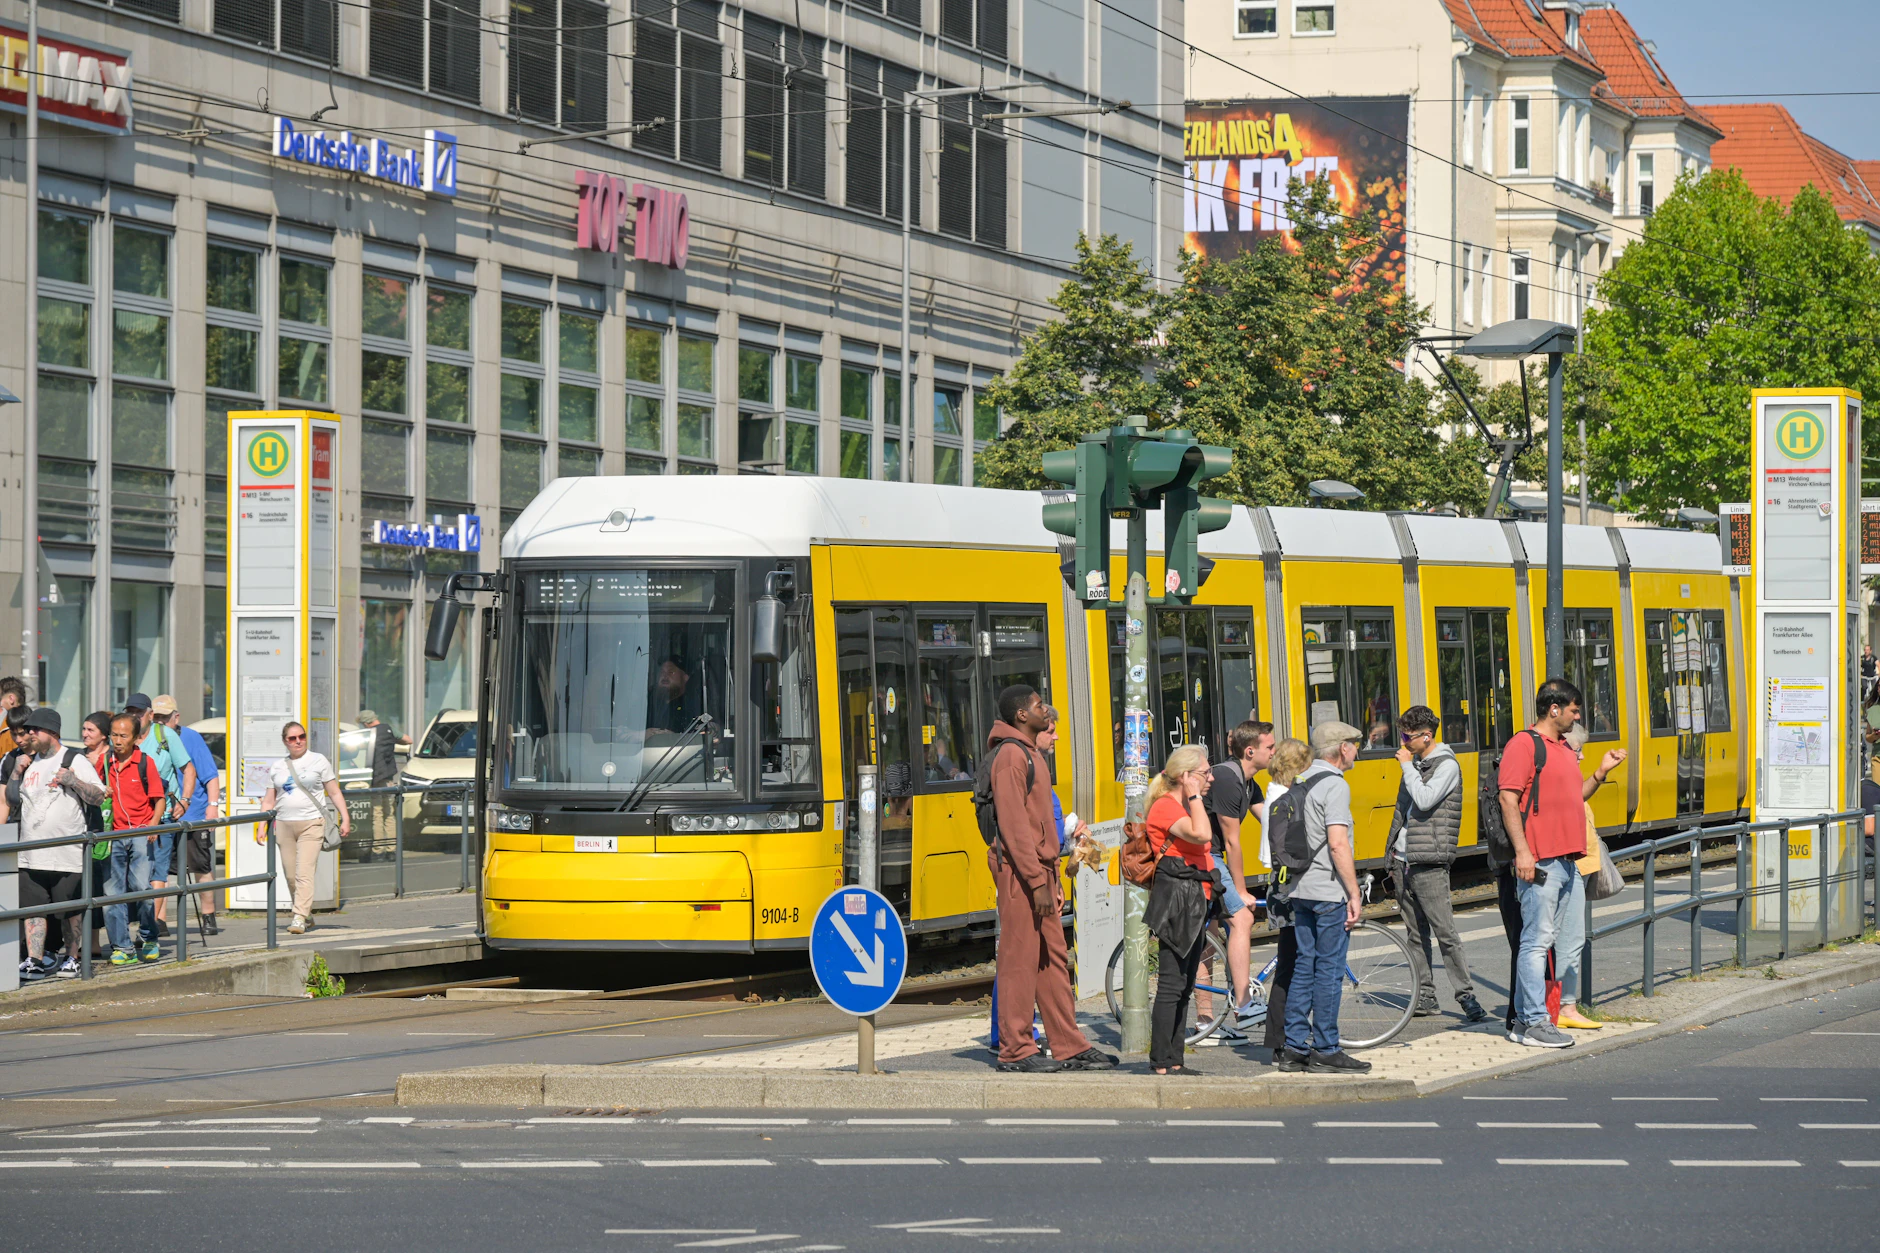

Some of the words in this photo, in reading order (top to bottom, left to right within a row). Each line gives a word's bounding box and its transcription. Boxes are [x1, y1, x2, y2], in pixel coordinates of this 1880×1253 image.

[0, 35, 133, 117] DIMAX
[1274, 113, 1304, 166] 4
[274, 117, 369, 172] Deutsche
[370, 138, 421, 188] Bank
[575, 170, 627, 253] TOP
[632, 183, 689, 270] TWO
[1731, 514, 1748, 522] M13
[374, 520, 429, 547] Deutsche
[428, 525, 459, 549] Bank
[1732, 531, 1749, 539] M13
[1738, 539, 1749, 547] 16
[1732, 548, 1750, 556] M13
[1089, 587, 1109, 598] RÖDEL
[351, 811, 368, 820] für
[577, 840, 600, 848] BERLIN
[1788, 844, 1809, 856] BVG
[761, 907, 799, 925] 9104-B
